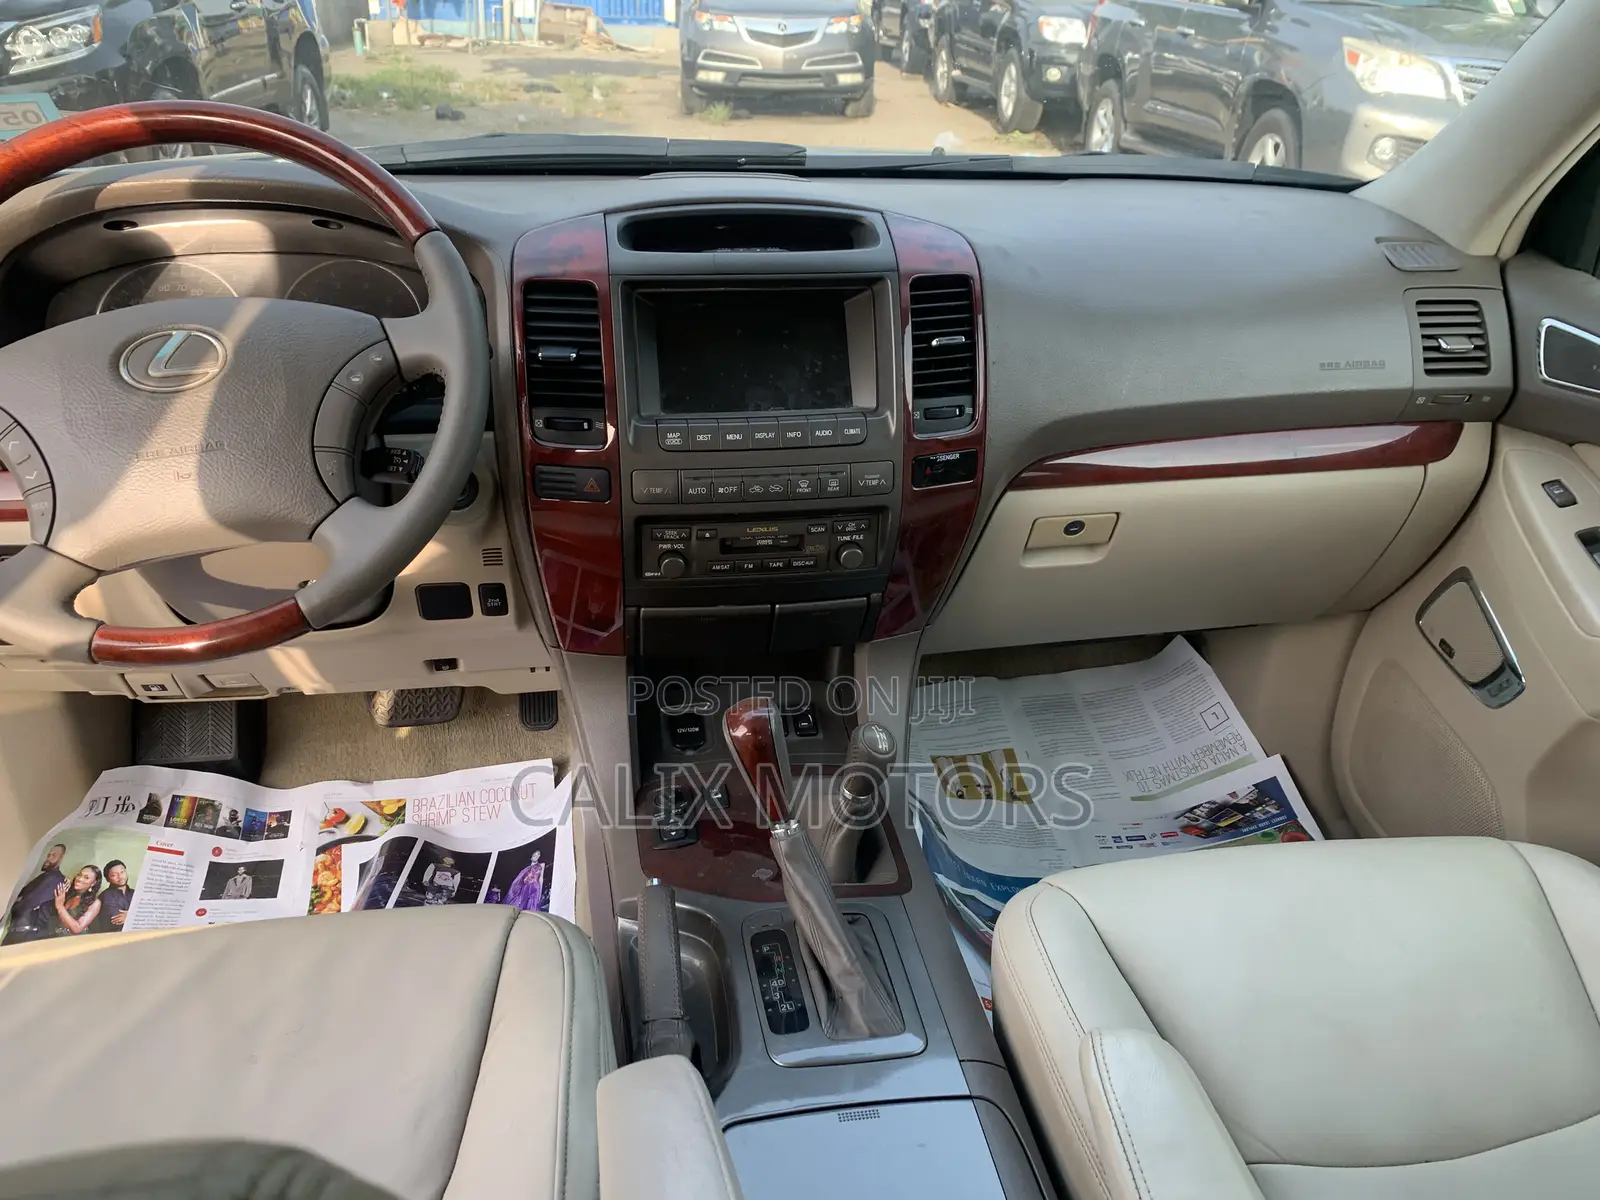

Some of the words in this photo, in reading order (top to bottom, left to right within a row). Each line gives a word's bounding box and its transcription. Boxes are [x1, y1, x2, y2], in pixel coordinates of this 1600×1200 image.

[726, 433, 743, 441] MENU
[1190, 729, 1243, 760] REMEMBER
[1161, 754, 1191, 773] WITH
[1209, 746, 1239, 765] NAIJA
[1152, 759, 1209, 790] CHRISTMAS
[1136, 780, 1152, 793] TO
[412, 790, 476, 814] BRAZILIAN
[480, 782, 537, 805] COCONUT
[461, 803, 502, 823] STEW
[155, 840, 174, 848] Cover
